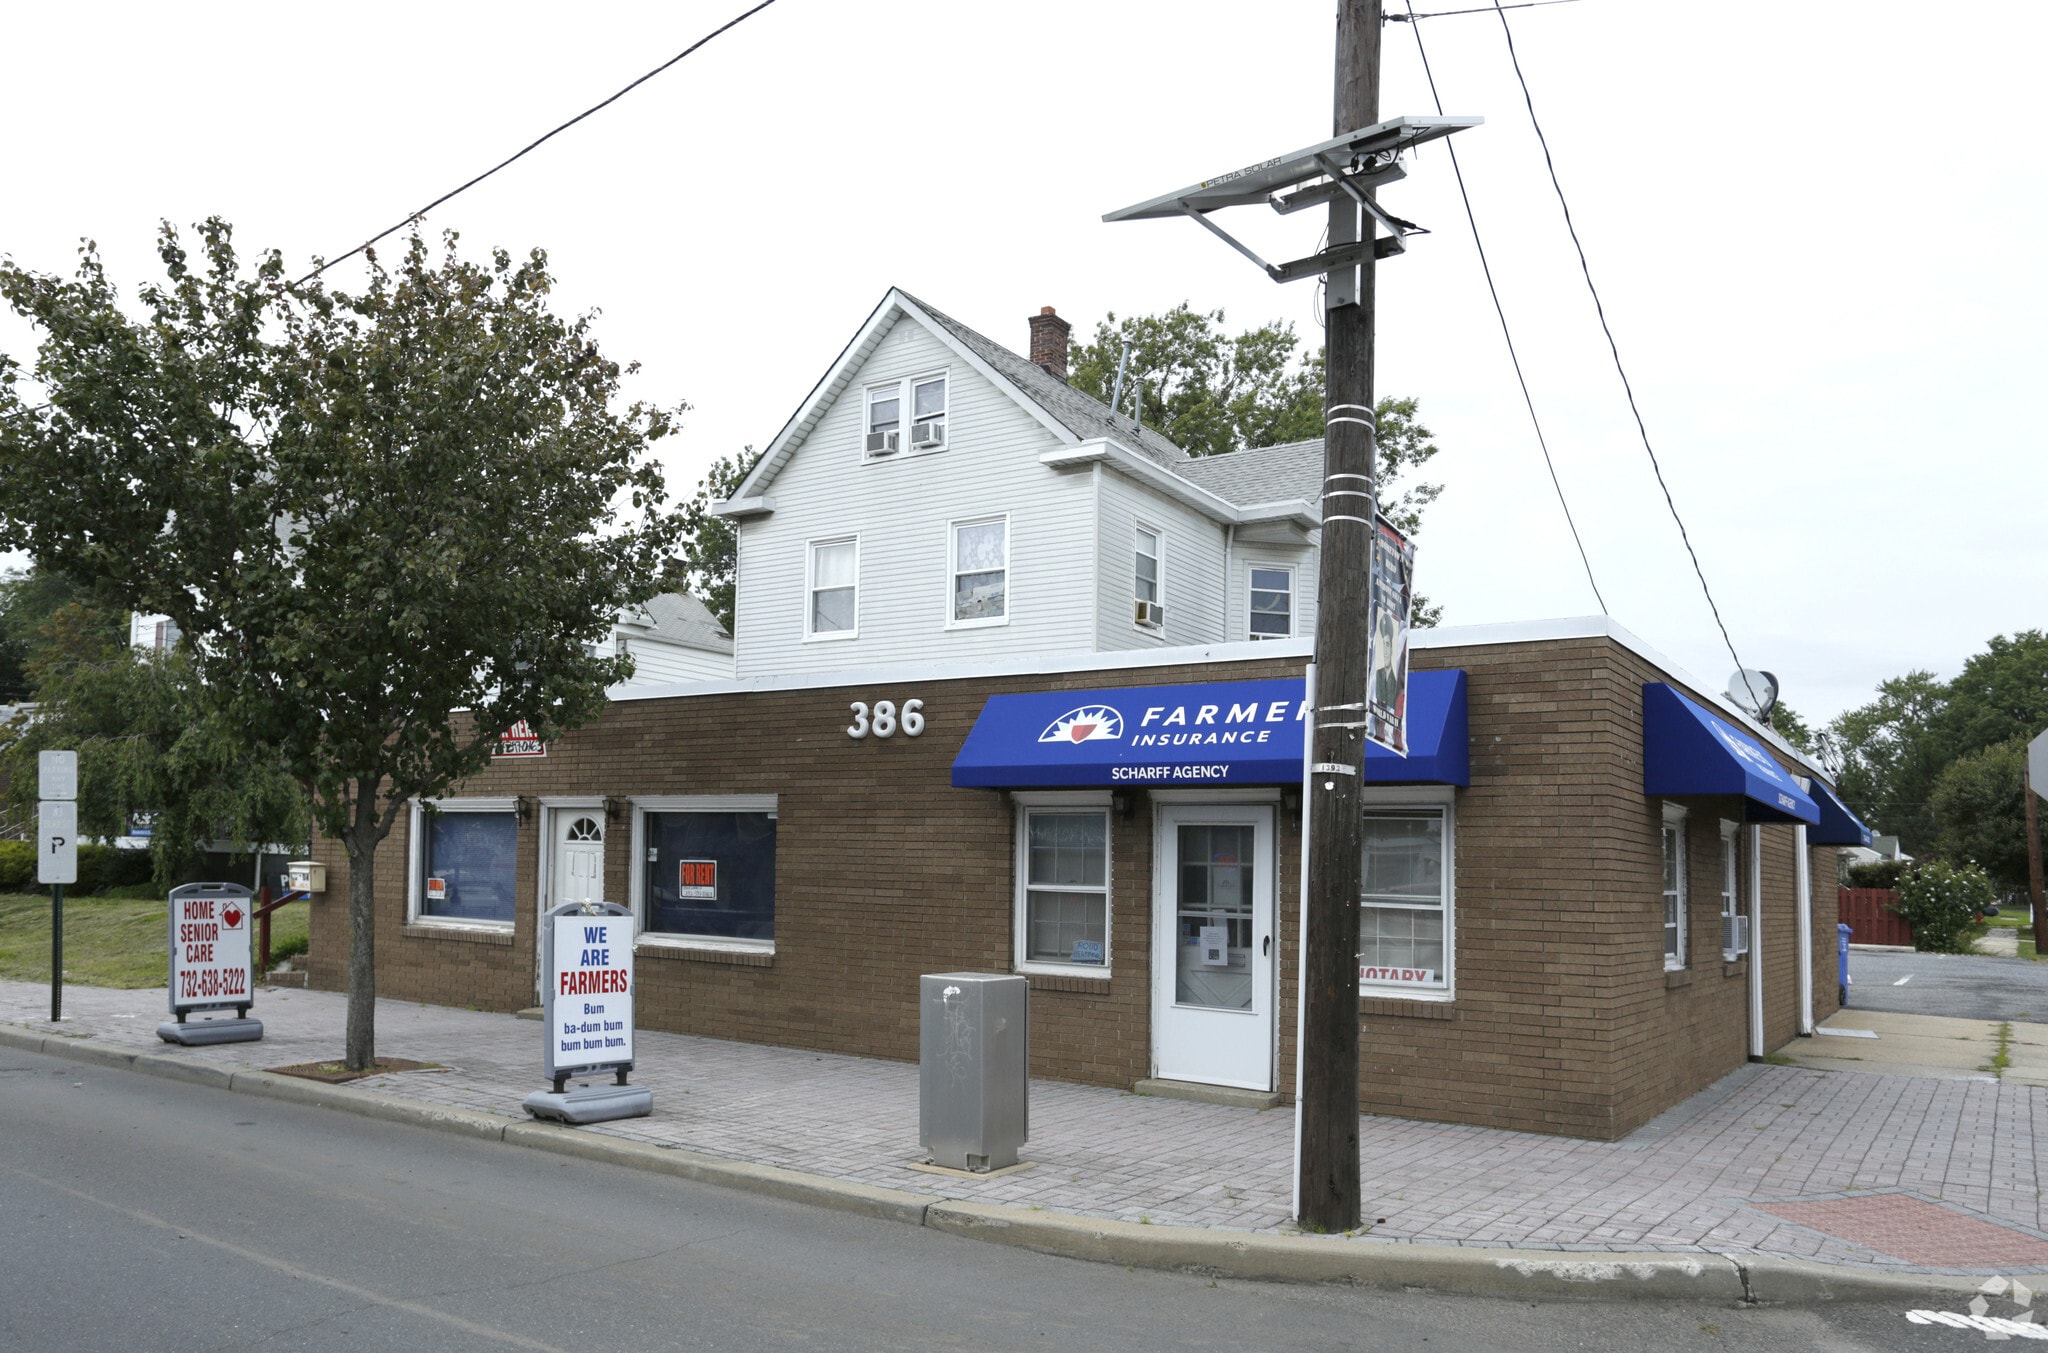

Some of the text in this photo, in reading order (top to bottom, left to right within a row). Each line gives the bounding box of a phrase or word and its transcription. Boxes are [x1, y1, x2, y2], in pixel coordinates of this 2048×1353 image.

[1206, 157, 1282, 188] PETRA SOLAR
[847, 698, 925, 739] 386
[1131, 730, 1271, 746] INSURANCE
[1112, 765, 1229, 780] SCHARFF AGENCY
[681, 863, 715, 885] FOR RENT
[184, 901, 215, 920] HOME
[180, 923, 219, 942] SENIOR
[584, 926, 607, 944] WE
[186, 944, 213, 963] CARE
[580, 949, 609, 966] ARE
[180, 968, 245, 998] 732-638-5222
[560, 969, 628, 995] FARMERS
[584, 1003, 605, 1015] Bum
[564, 1020, 623, 1034] ba-dum bum
[561, 1036, 626, 1051] bum bum bum.
